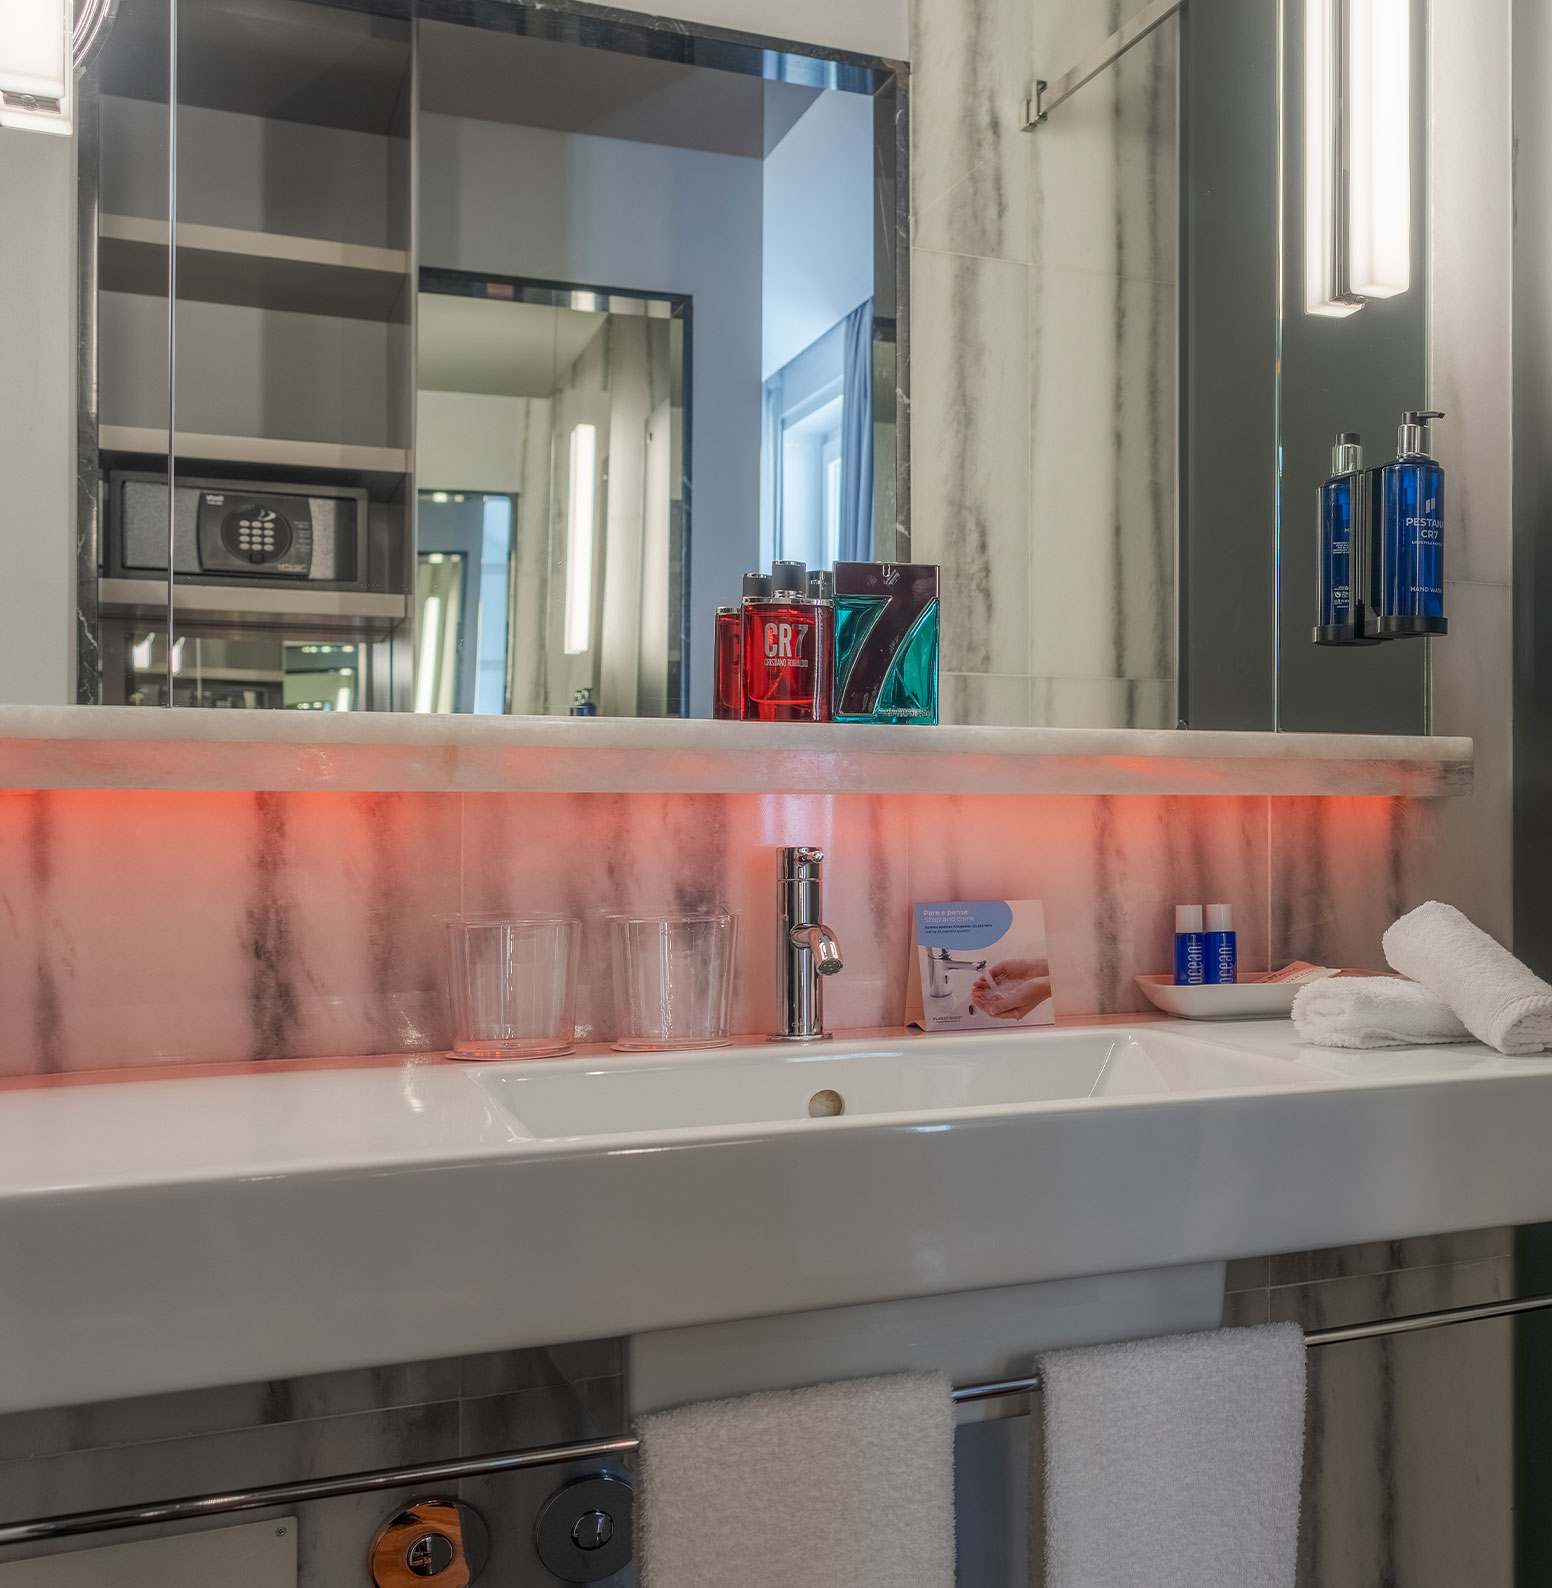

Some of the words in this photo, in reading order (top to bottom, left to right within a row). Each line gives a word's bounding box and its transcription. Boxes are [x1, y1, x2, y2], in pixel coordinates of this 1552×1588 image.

[1420, 529, 1439, 539] CR7
[764, 622, 809, 658] CR7
[764, 658, 787, 667] CRISTIANO
[1187, 946, 1203, 984] ocean
[1218, 947, 1234, 984] ocean
